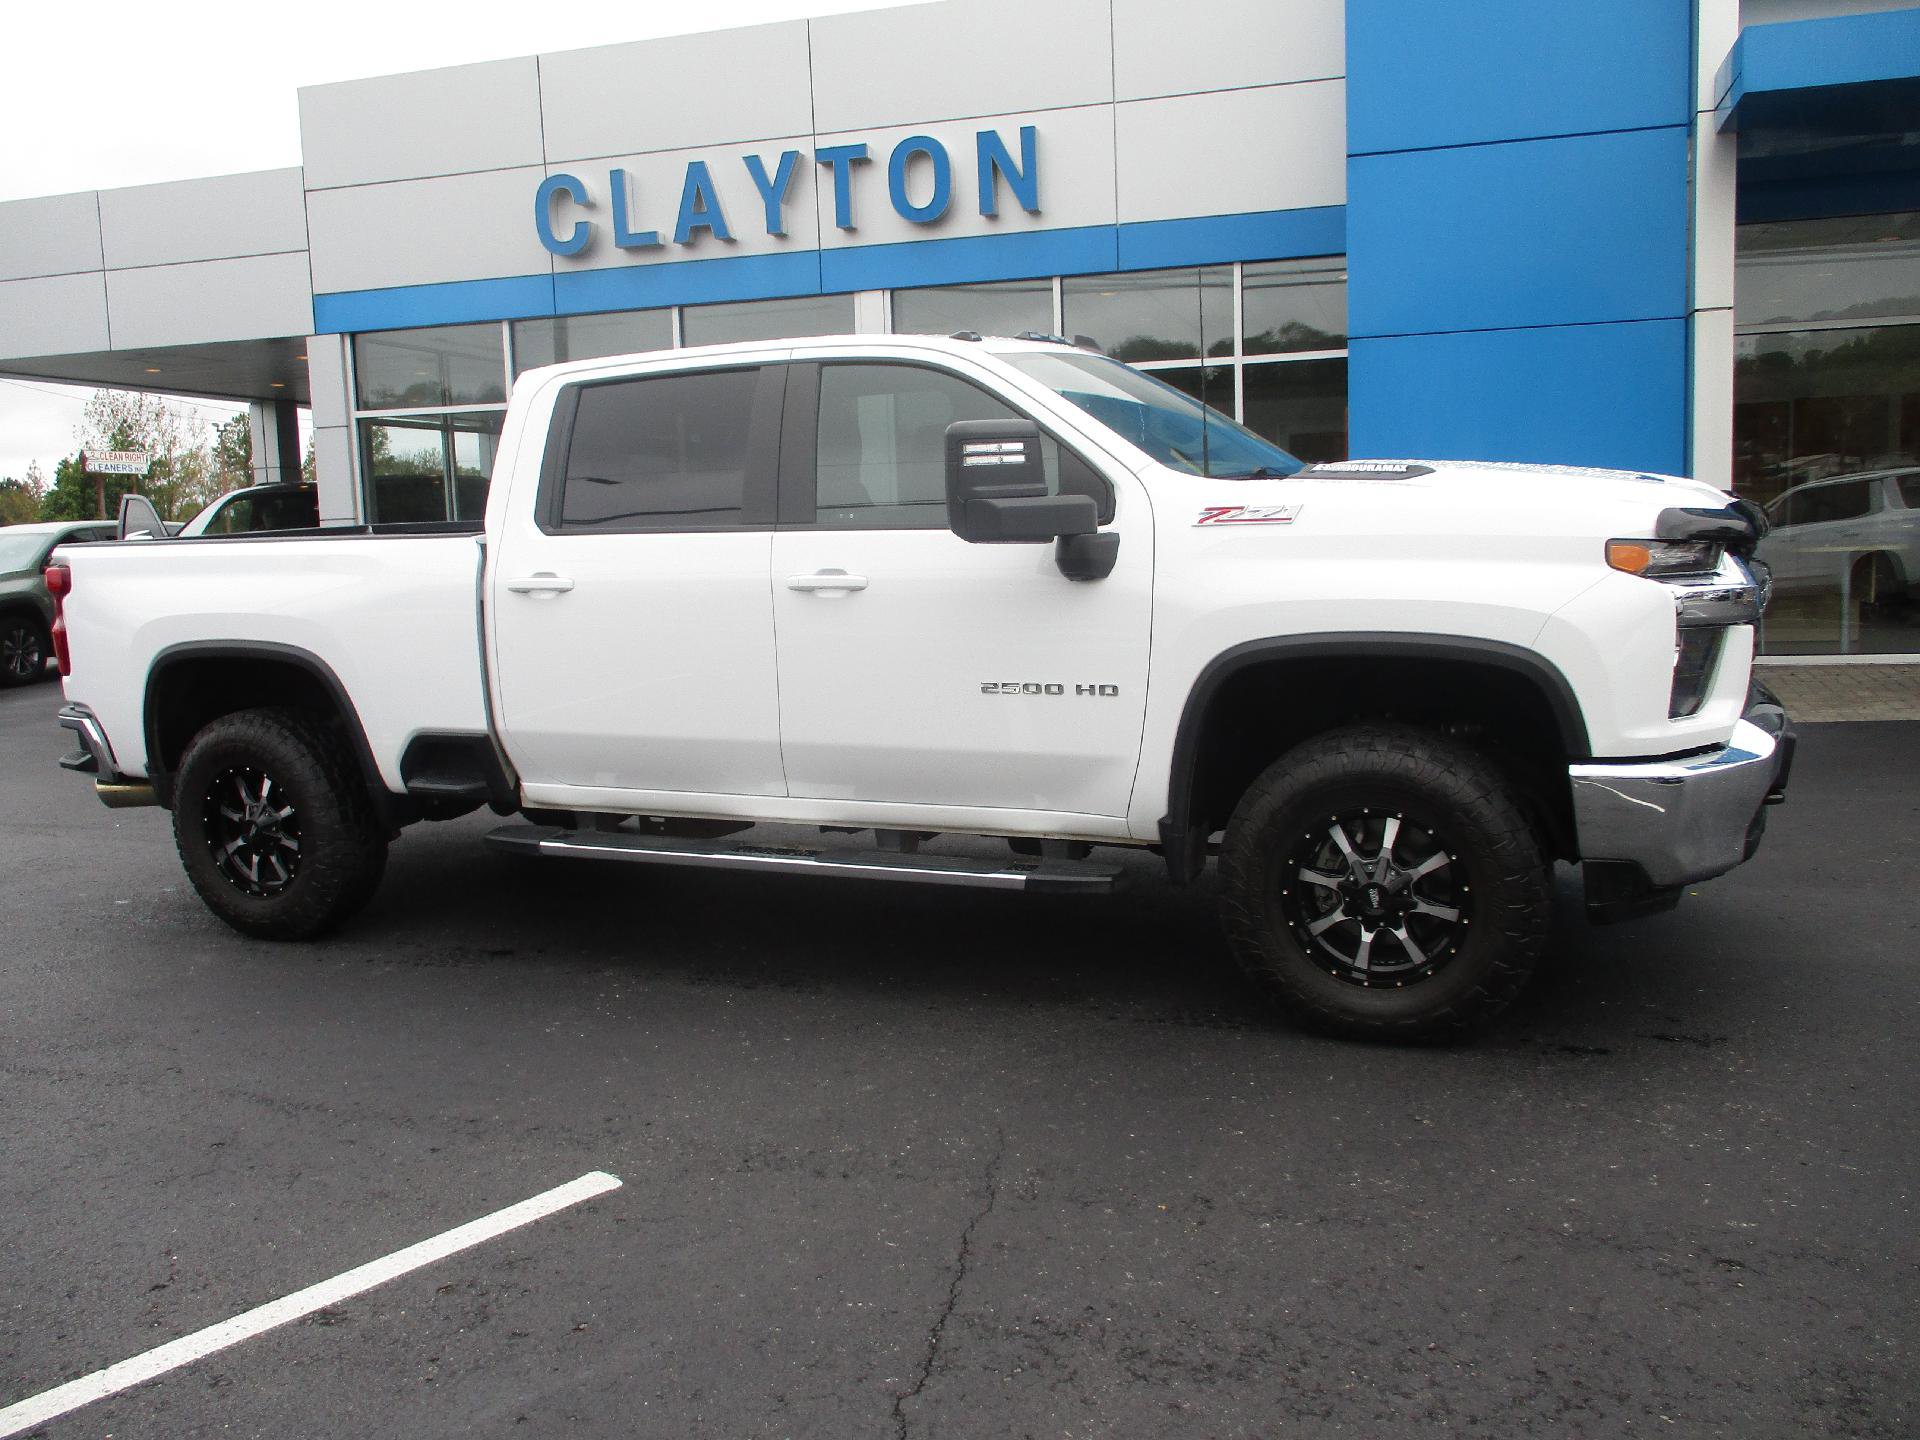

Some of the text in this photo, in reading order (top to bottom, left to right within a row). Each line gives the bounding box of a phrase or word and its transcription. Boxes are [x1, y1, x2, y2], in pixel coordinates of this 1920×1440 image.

[534, 125, 1041, 257] CLAYTON
[99, 451, 123, 461] CLEAN
[125, 453, 146, 462] RIGHT
[87, 462, 133, 472] CLEANERS
[1347, 464, 1408, 472] DURAMAX
[1195, 504, 1303, 526] Z71
[980, 682, 1119, 696] 2500 HD
